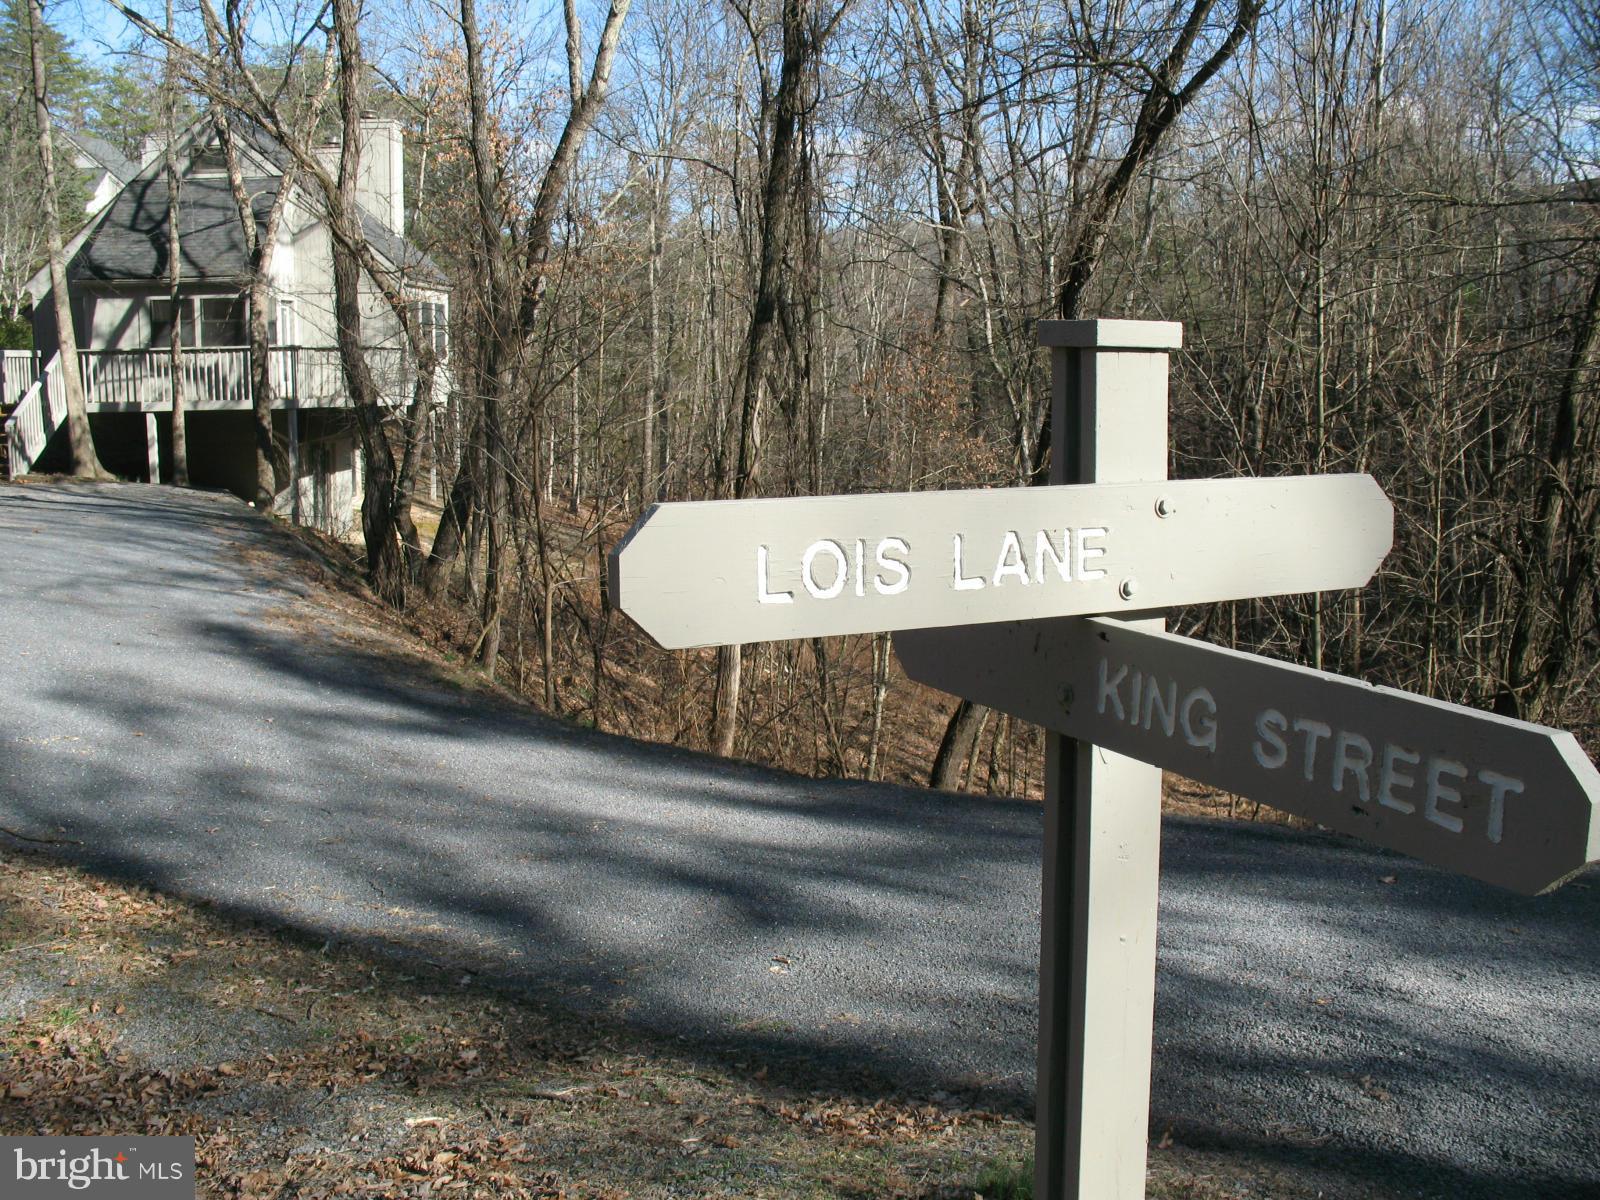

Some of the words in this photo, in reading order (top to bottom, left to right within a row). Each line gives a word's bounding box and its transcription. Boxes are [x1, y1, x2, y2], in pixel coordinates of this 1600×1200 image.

[757, 537, 910, 603] LOIS
[953, 526, 1108, 590] LANE
[1099, 658, 1217, 753] KING
[1252, 708, 1524, 844] STREET
